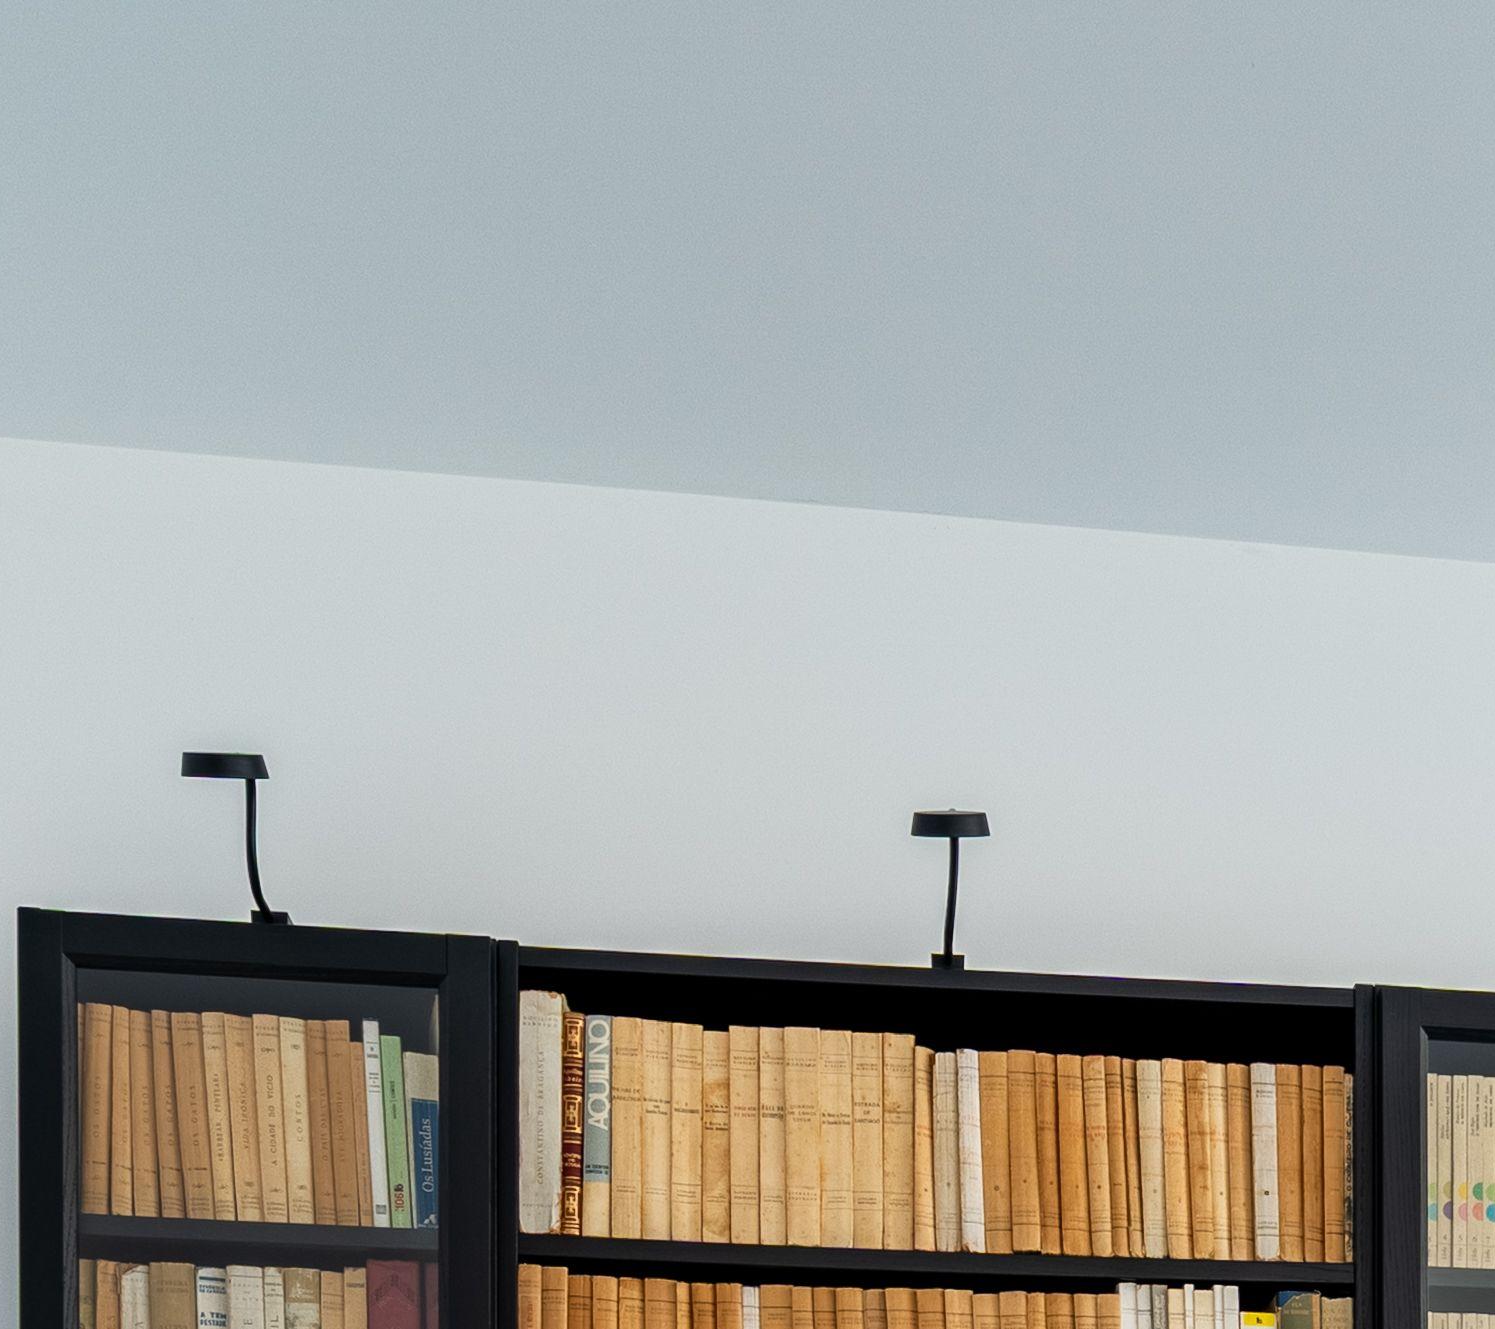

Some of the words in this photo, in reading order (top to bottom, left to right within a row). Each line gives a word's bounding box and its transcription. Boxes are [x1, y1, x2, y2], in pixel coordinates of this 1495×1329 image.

[588, 1019, 610, 1130] AQUILINO
[419, 1118, 434, 1175] Lusíadas
[423, 1176, 434, 1193] Os
